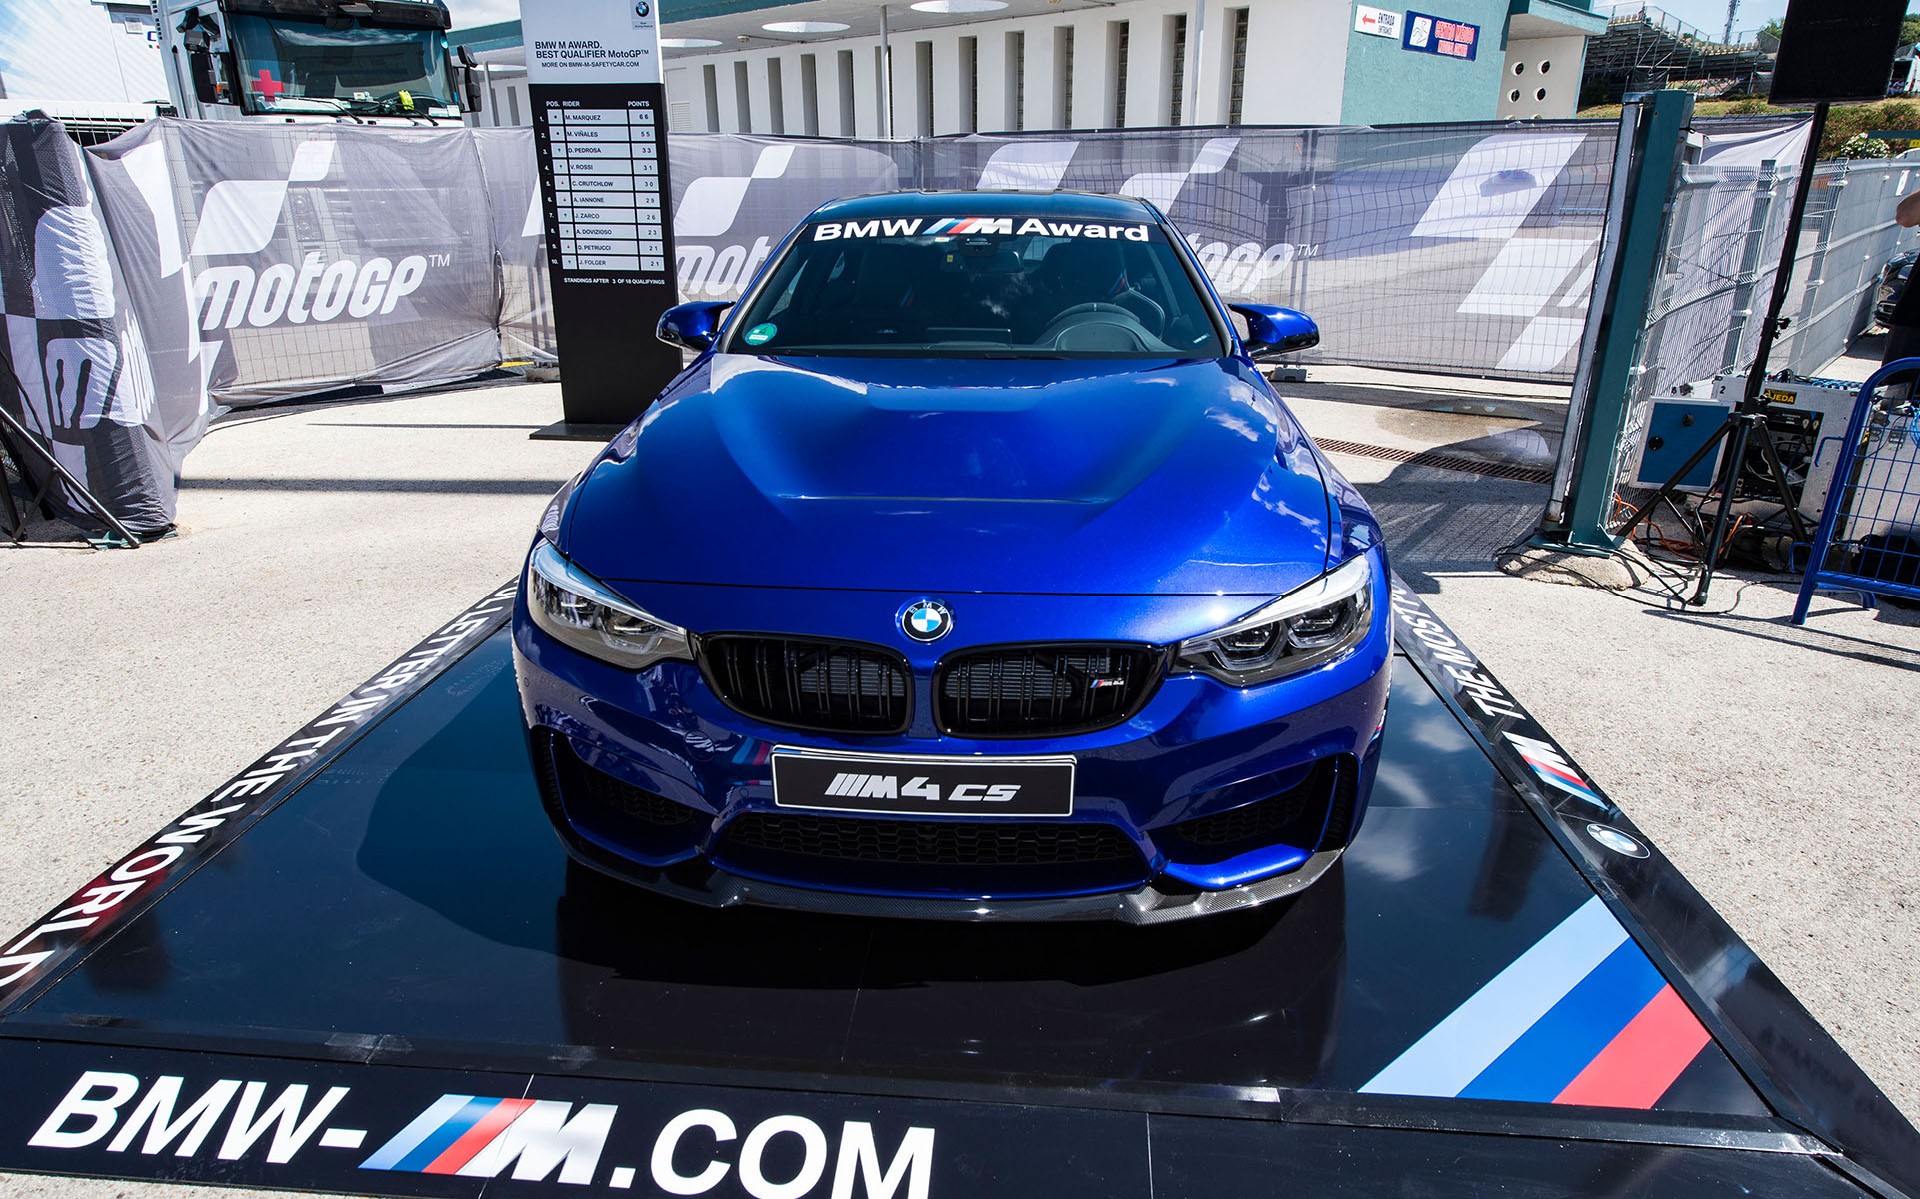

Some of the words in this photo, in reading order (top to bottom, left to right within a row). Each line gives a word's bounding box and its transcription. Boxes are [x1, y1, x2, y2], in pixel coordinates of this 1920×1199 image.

[535, 41, 557, 49] BMW
[559, 41, 566, 49] M
[568, 41, 602, 49] AWARD.
[536, 50, 558, 59] BEST
[560, 50, 606, 59] QUALIFIER
[813, 218, 923, 242] BMW
[1017, 218, 1149, 242] Award
[360, 607, 503, 694] LETTER
[1393, 603, 1479, 669] MOST
[313, 694, 389, 728] IN
[1450, 667, 1527, 721] THE
[210, 727, 346, 802] THE
[948, 784, 1022, 801] CS
[0, 803, 246, 986] WORLD
